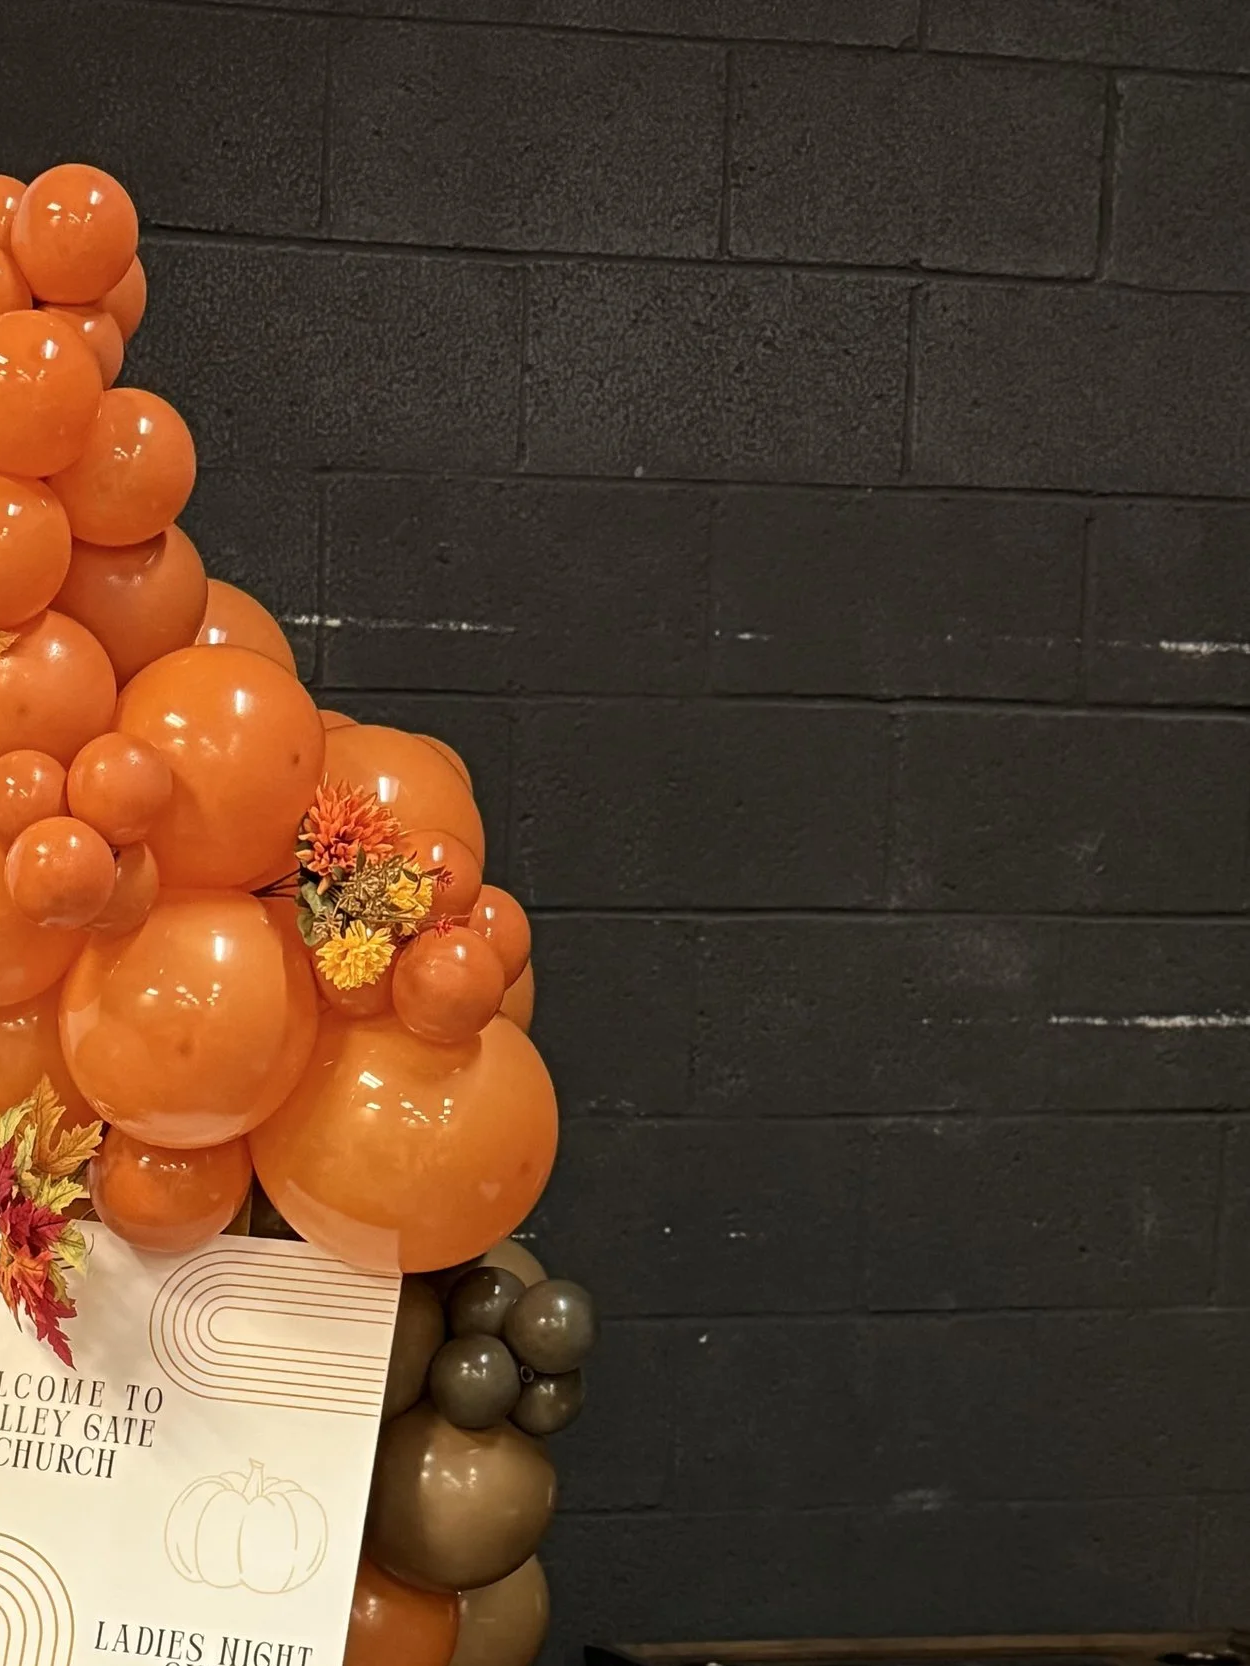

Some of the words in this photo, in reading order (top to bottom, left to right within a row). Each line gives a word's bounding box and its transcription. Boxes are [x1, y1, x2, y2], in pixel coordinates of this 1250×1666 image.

[125, 1383, 164, 1414] TO
[83, 1412, 157, 1448] GATE
[94, 1620, 206, 1663] LADIES
